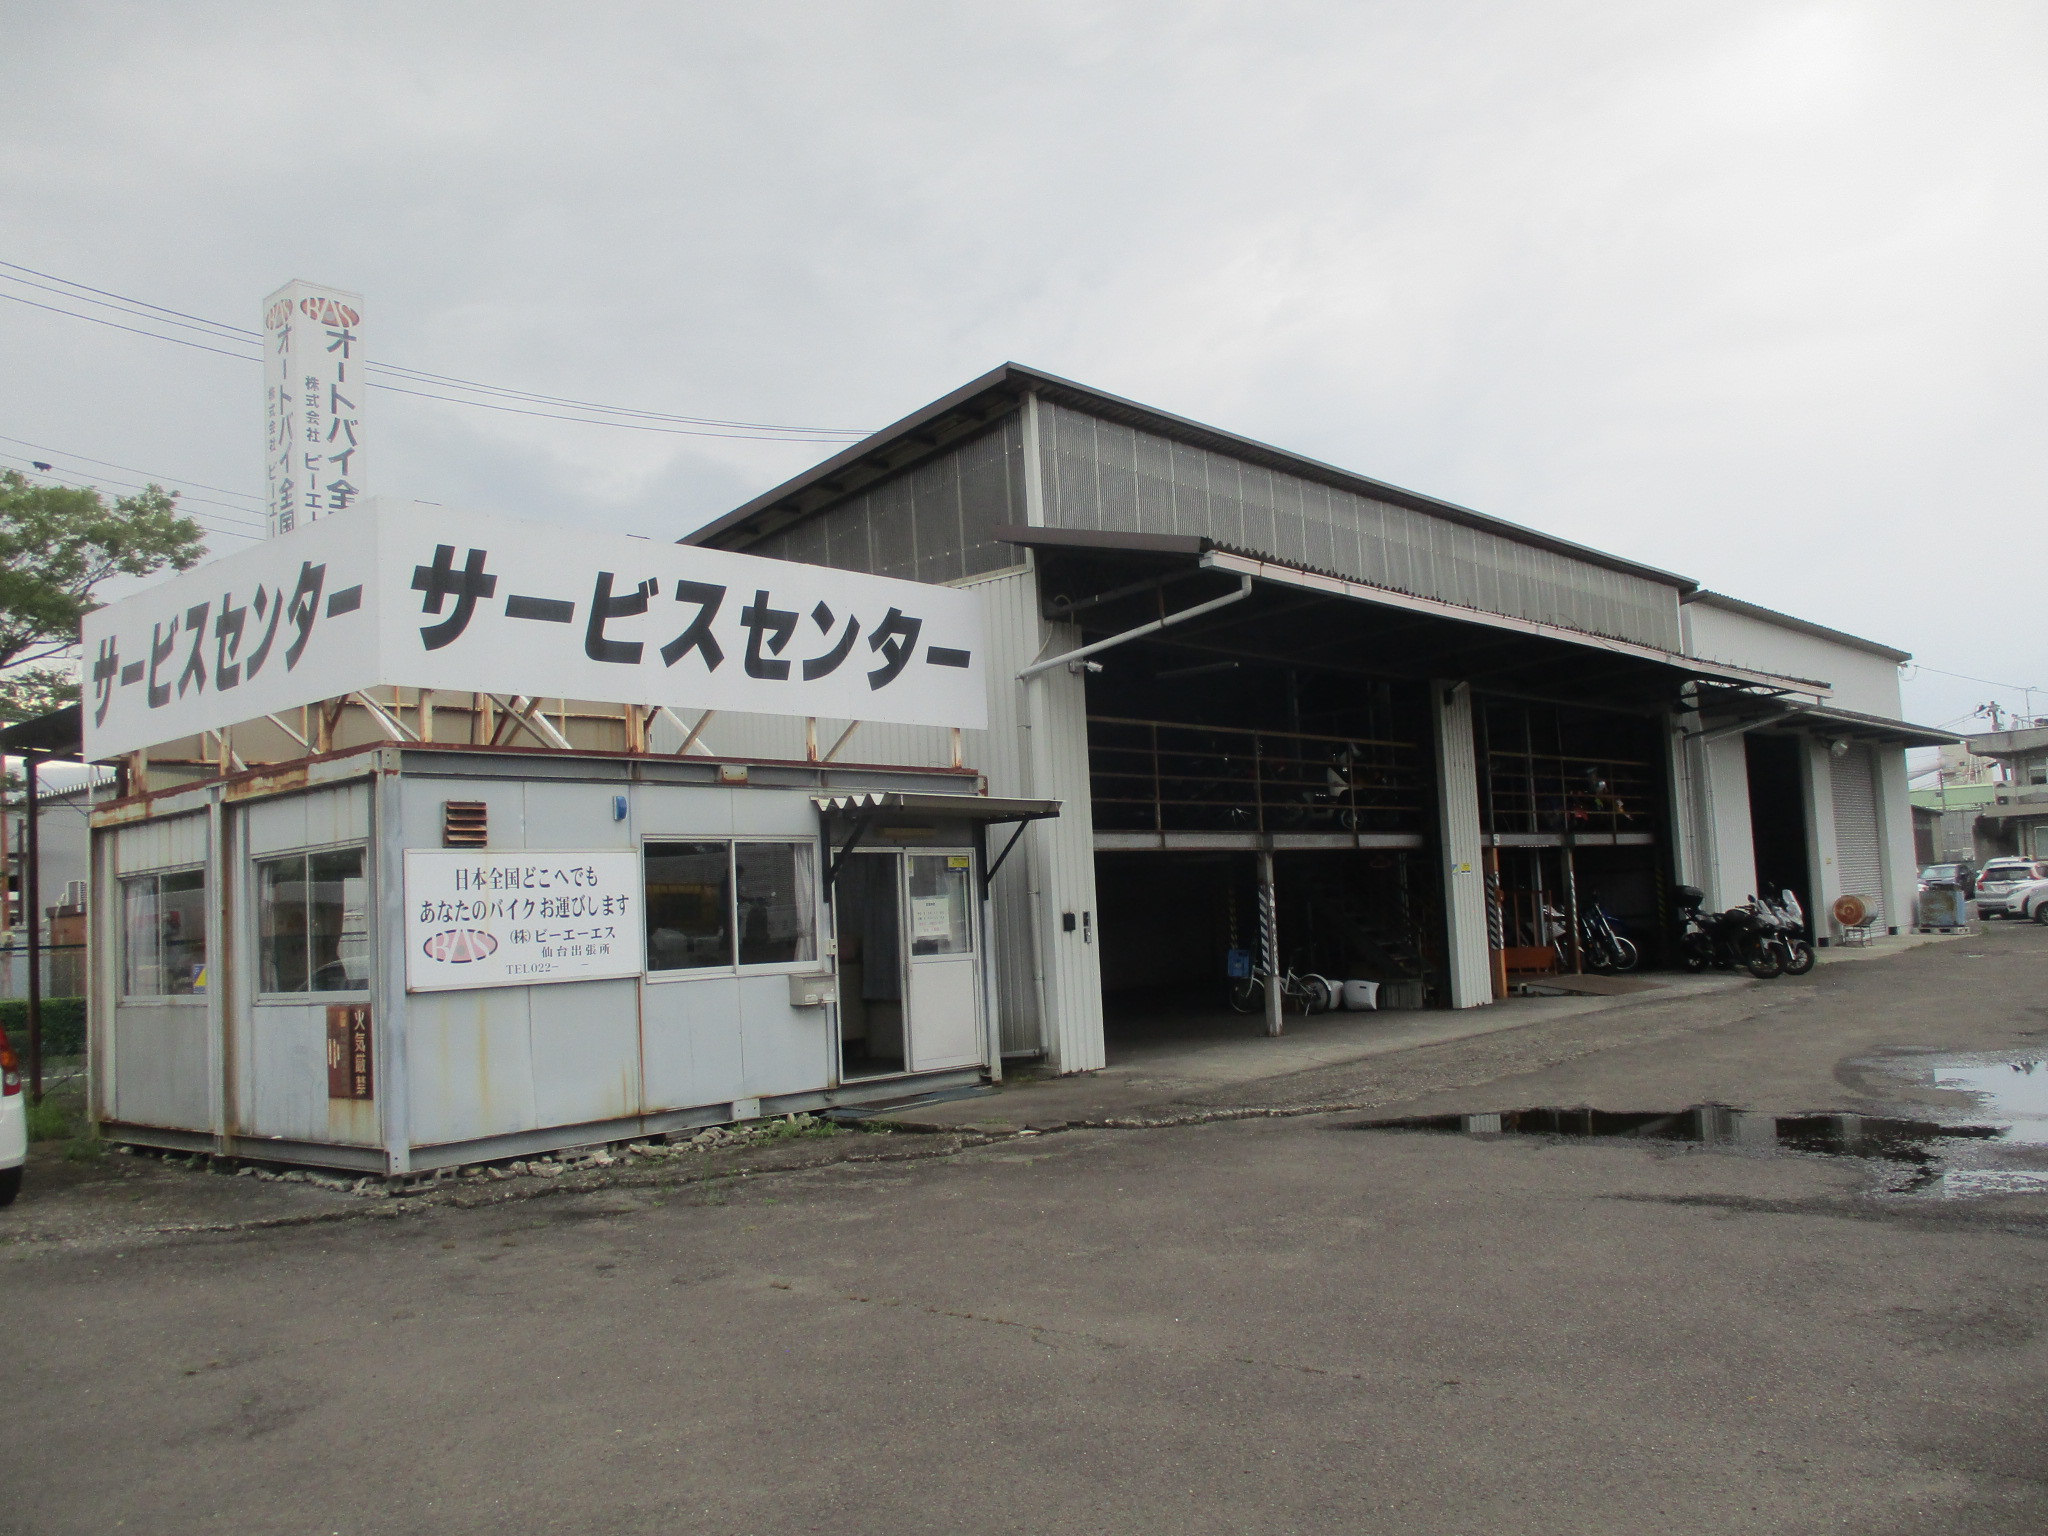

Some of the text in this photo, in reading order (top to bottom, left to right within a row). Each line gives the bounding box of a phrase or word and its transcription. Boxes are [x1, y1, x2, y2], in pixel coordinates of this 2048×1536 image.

[326, 329, 360, 515] オートバイ全
[93, 559, 363, 730] サービスセンター
[411, 543, 972, 692] サービスセンター
[456, 866, 598, 891] 日本全国どこへでも
[541, 944, 611, 959] 仙台出張所
[353, 1009, 367, 1095] 火気厳禁
